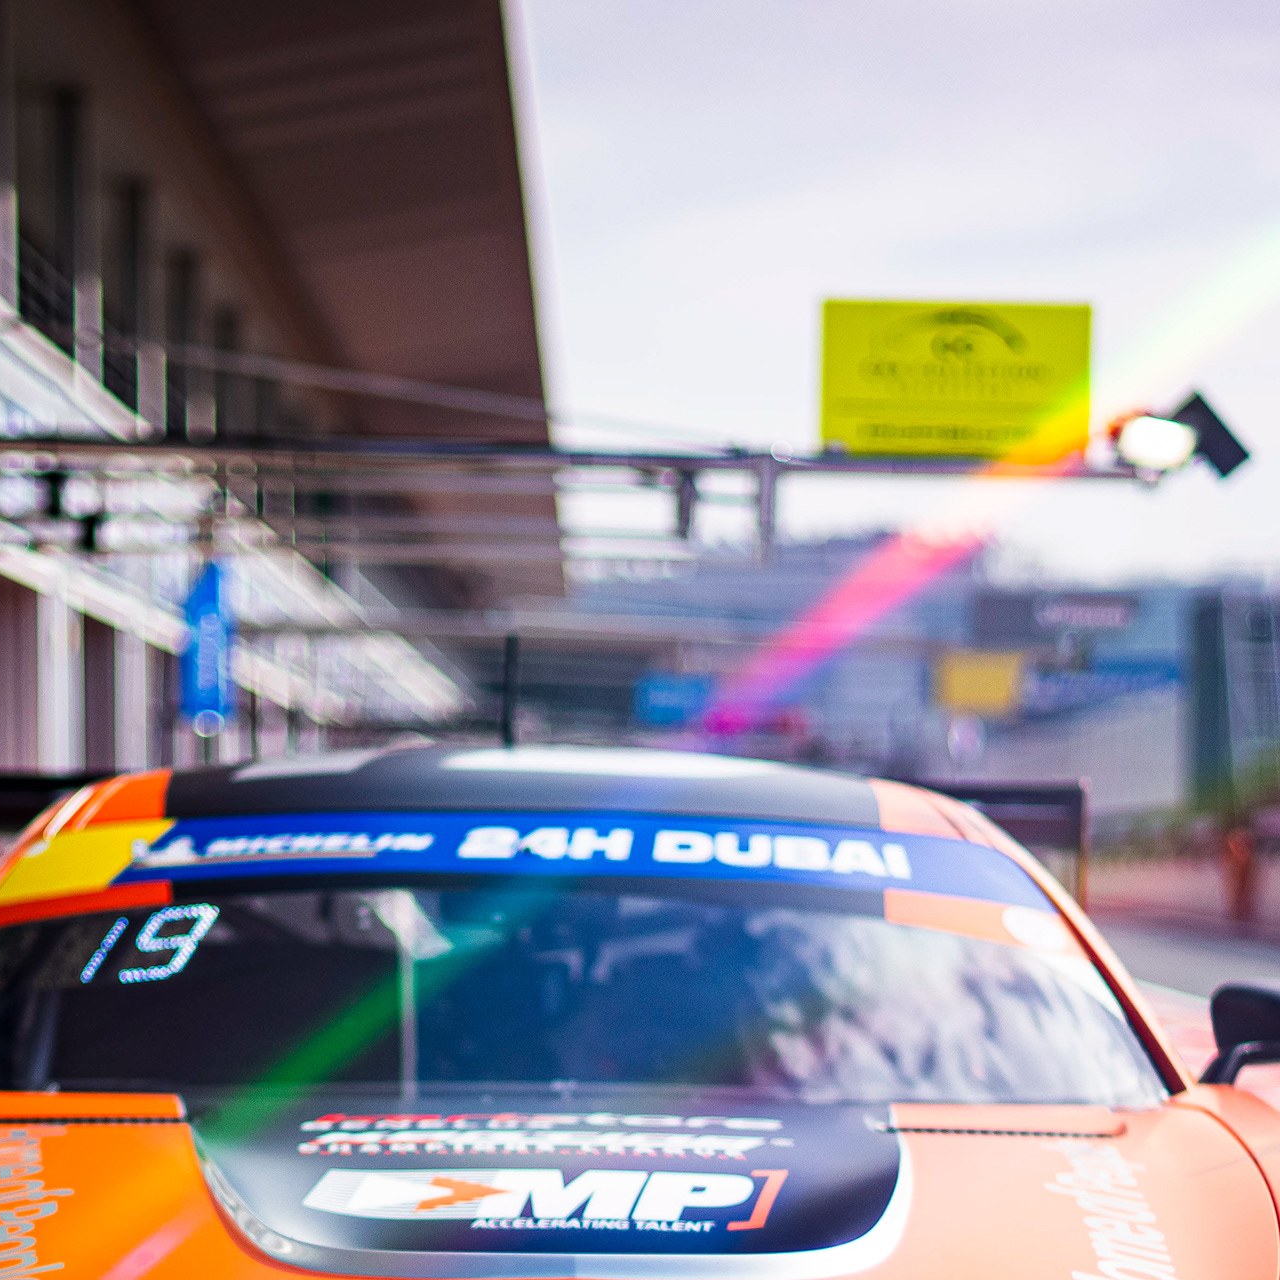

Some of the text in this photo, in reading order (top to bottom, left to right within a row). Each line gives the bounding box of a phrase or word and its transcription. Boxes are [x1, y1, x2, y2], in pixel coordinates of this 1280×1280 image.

[205, 826, 913, 880] MICHELIN 24H DUBAI
[470, 1218, 718, 1233] ACCELERATING TALENT
